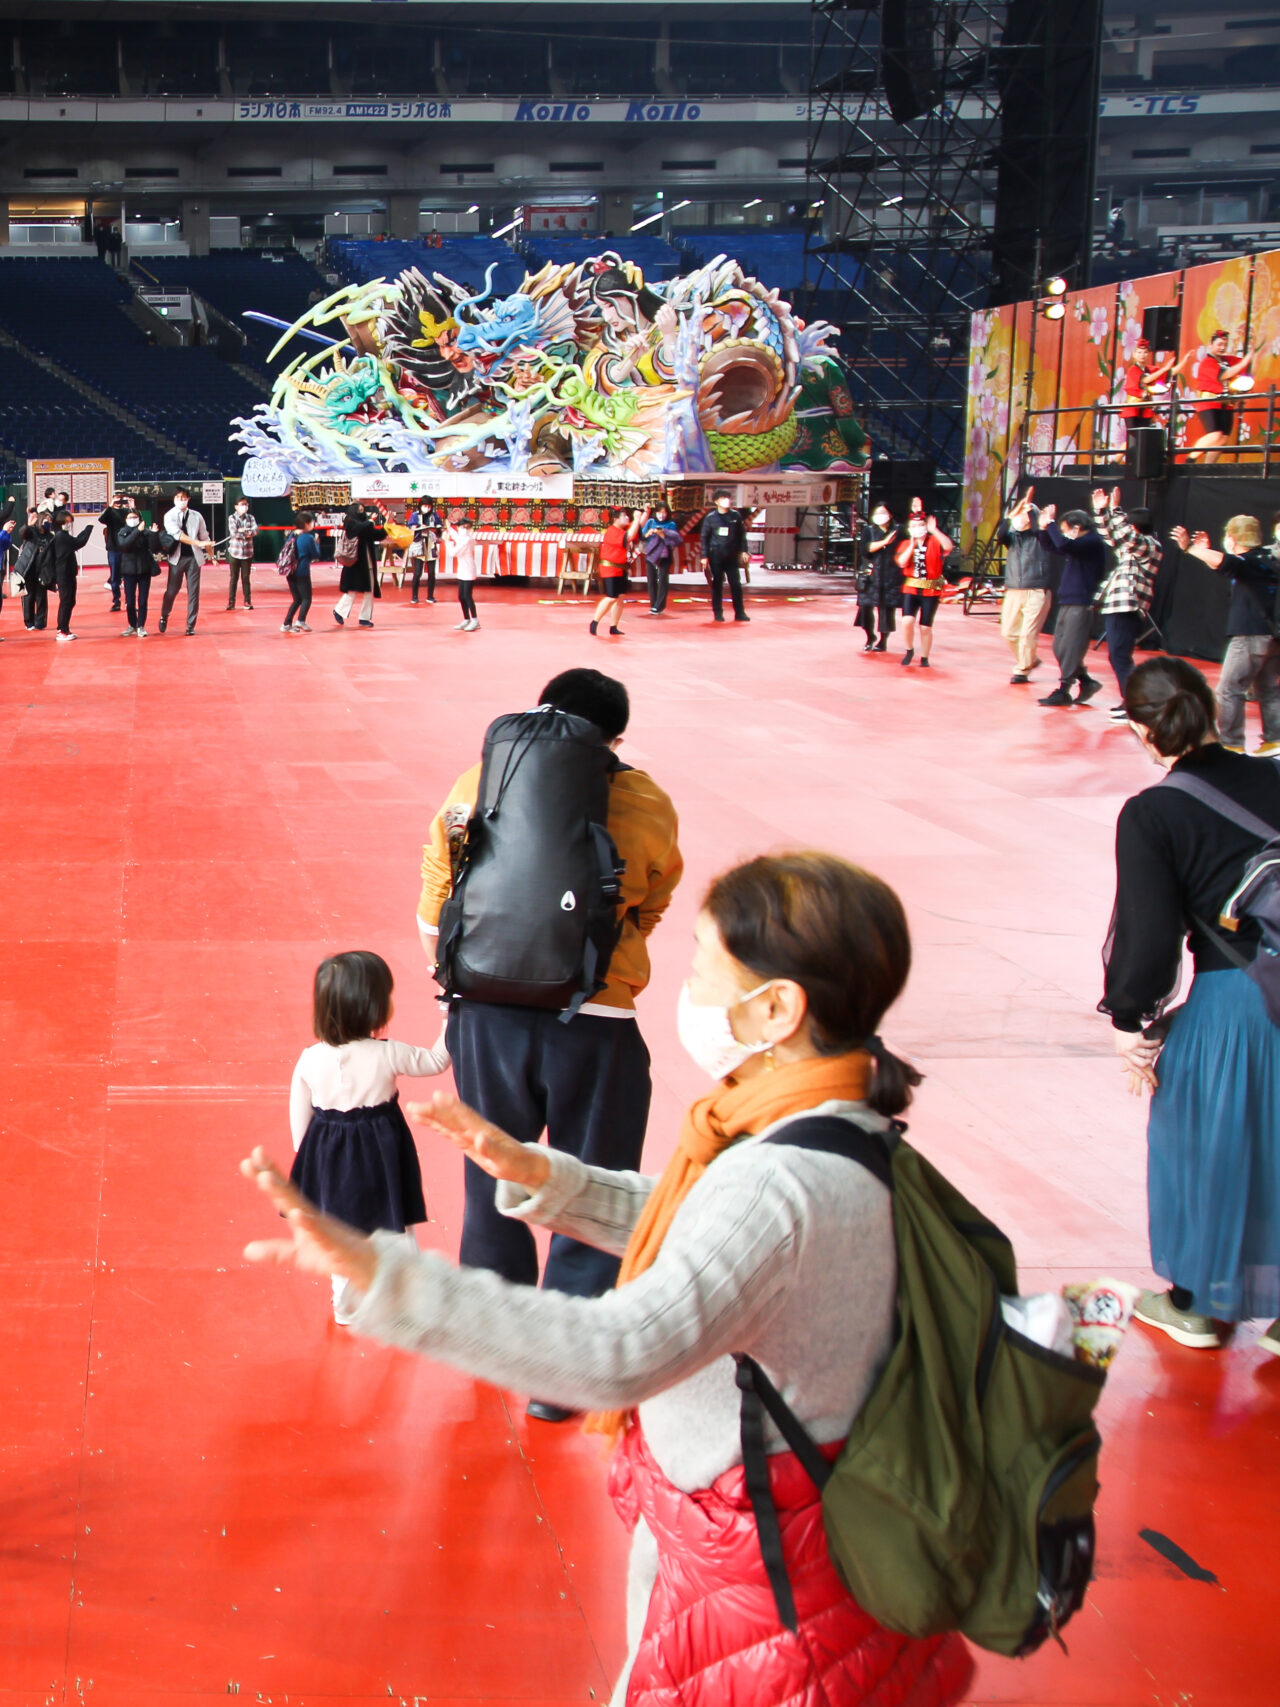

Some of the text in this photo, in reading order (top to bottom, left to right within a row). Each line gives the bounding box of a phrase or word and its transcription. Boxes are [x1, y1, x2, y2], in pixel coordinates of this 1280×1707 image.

[240, 103, 451, 118] ラジオ日本 FM92.4 AM1422 ラジオ日本
